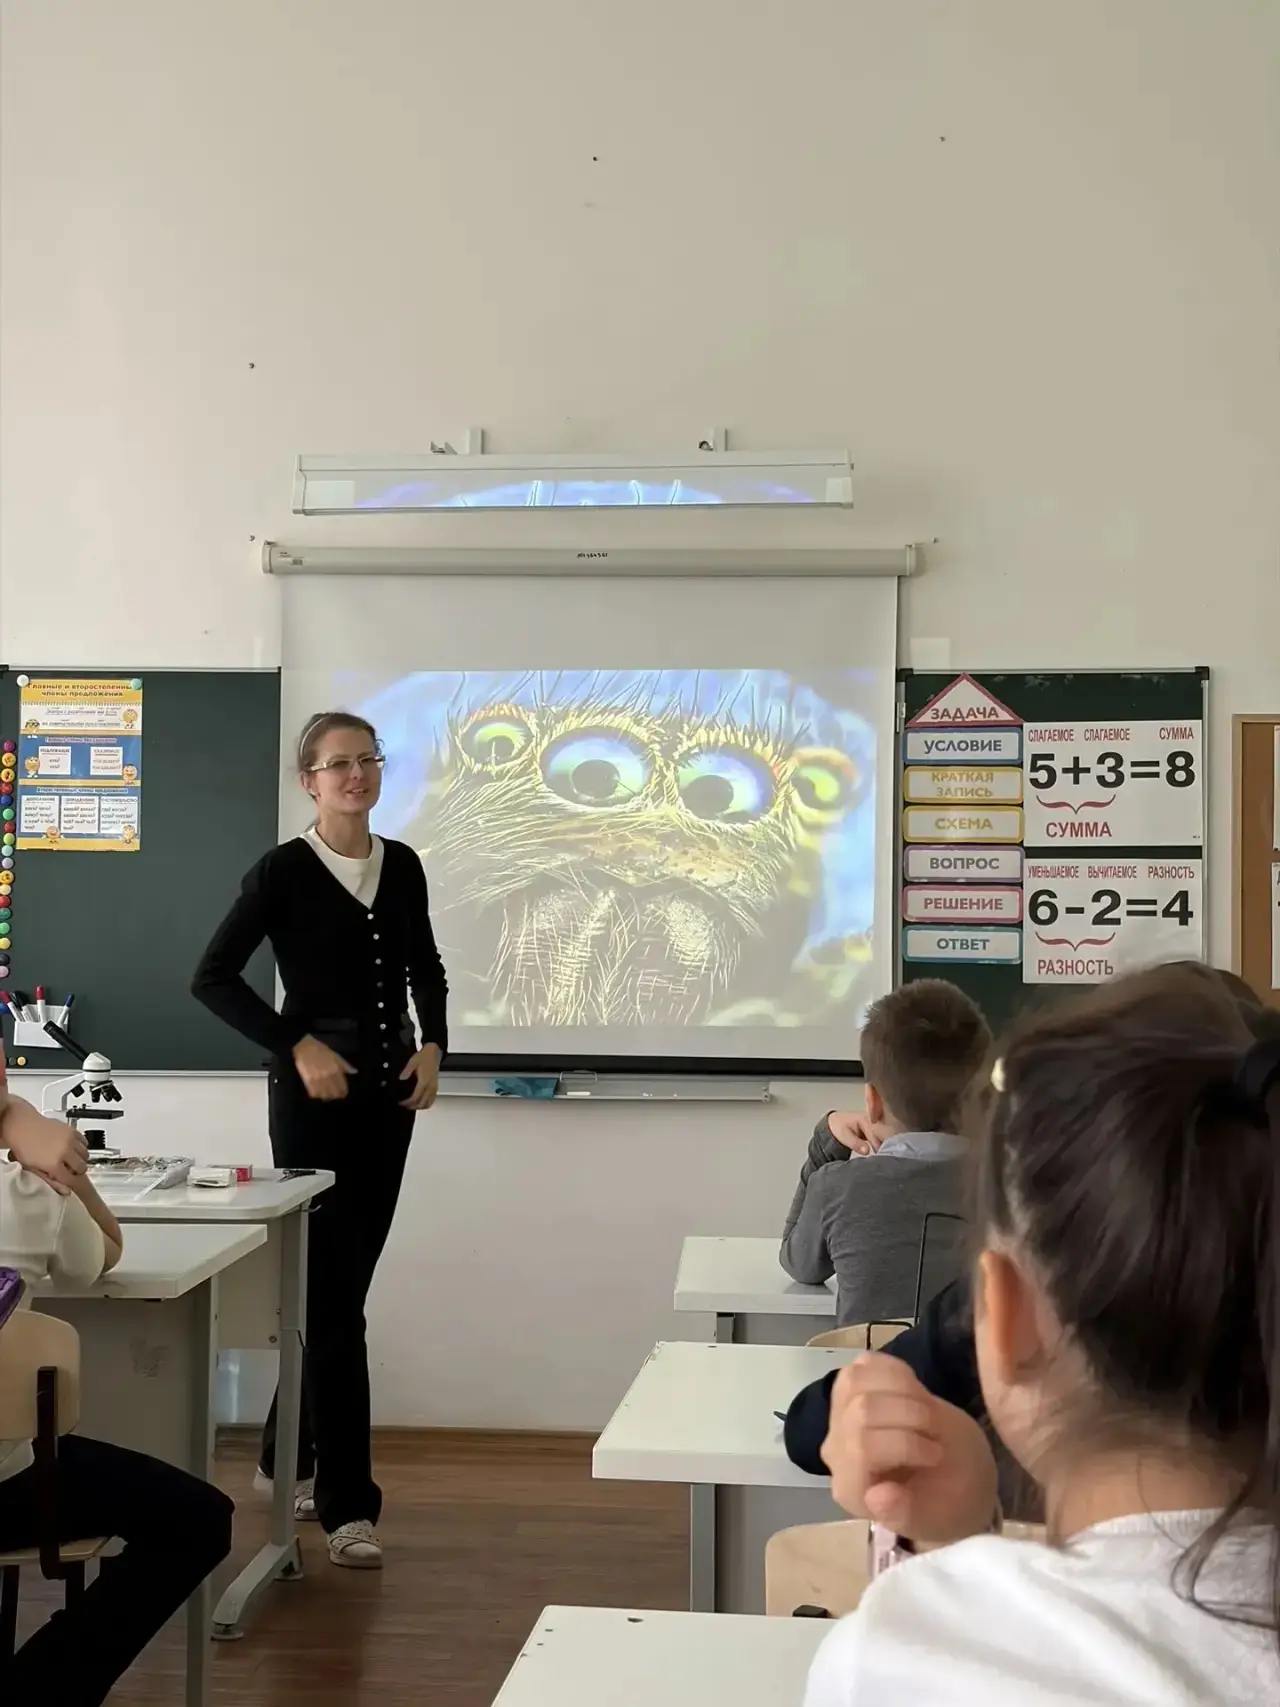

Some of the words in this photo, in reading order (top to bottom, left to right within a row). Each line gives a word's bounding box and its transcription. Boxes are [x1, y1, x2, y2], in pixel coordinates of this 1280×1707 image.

[930, 706, 1000, 722] ЗАДАЧА
[1028, 728, 1074, 742] СЛАГАЕМОЕ
[1084, 728, 1131, 741] СЛАГАЕМОЕ
[1159, 727, 1194, 740] СУММА
[924, 739, 1002, 755] УСЛОВИЕ
[931, 772, 994, 783] КРАТКАЯ
[936, 787, 993, 797] ЗАПИСЬ
[934, 818, 993, 830] СХЕМА
[1046, 821, 1113, 838] СУММА
[929, 857, 1000, 870] ВОПРОС
[1028, 866, 1080, 878] УМЕНЬШАЕМОЕ
[1087, 866, 1137, 878] ВЫЧИТАЕМОЕ
[1148, 866, 1195, 879] РАЗНОСТЬ
[924, 897, 1004, 911] РЕШЕНИЕ
[936, 938, 990, 951] ОТВЕТ
[1038, 959, 1114, 976] РАЗНОСТЬ
